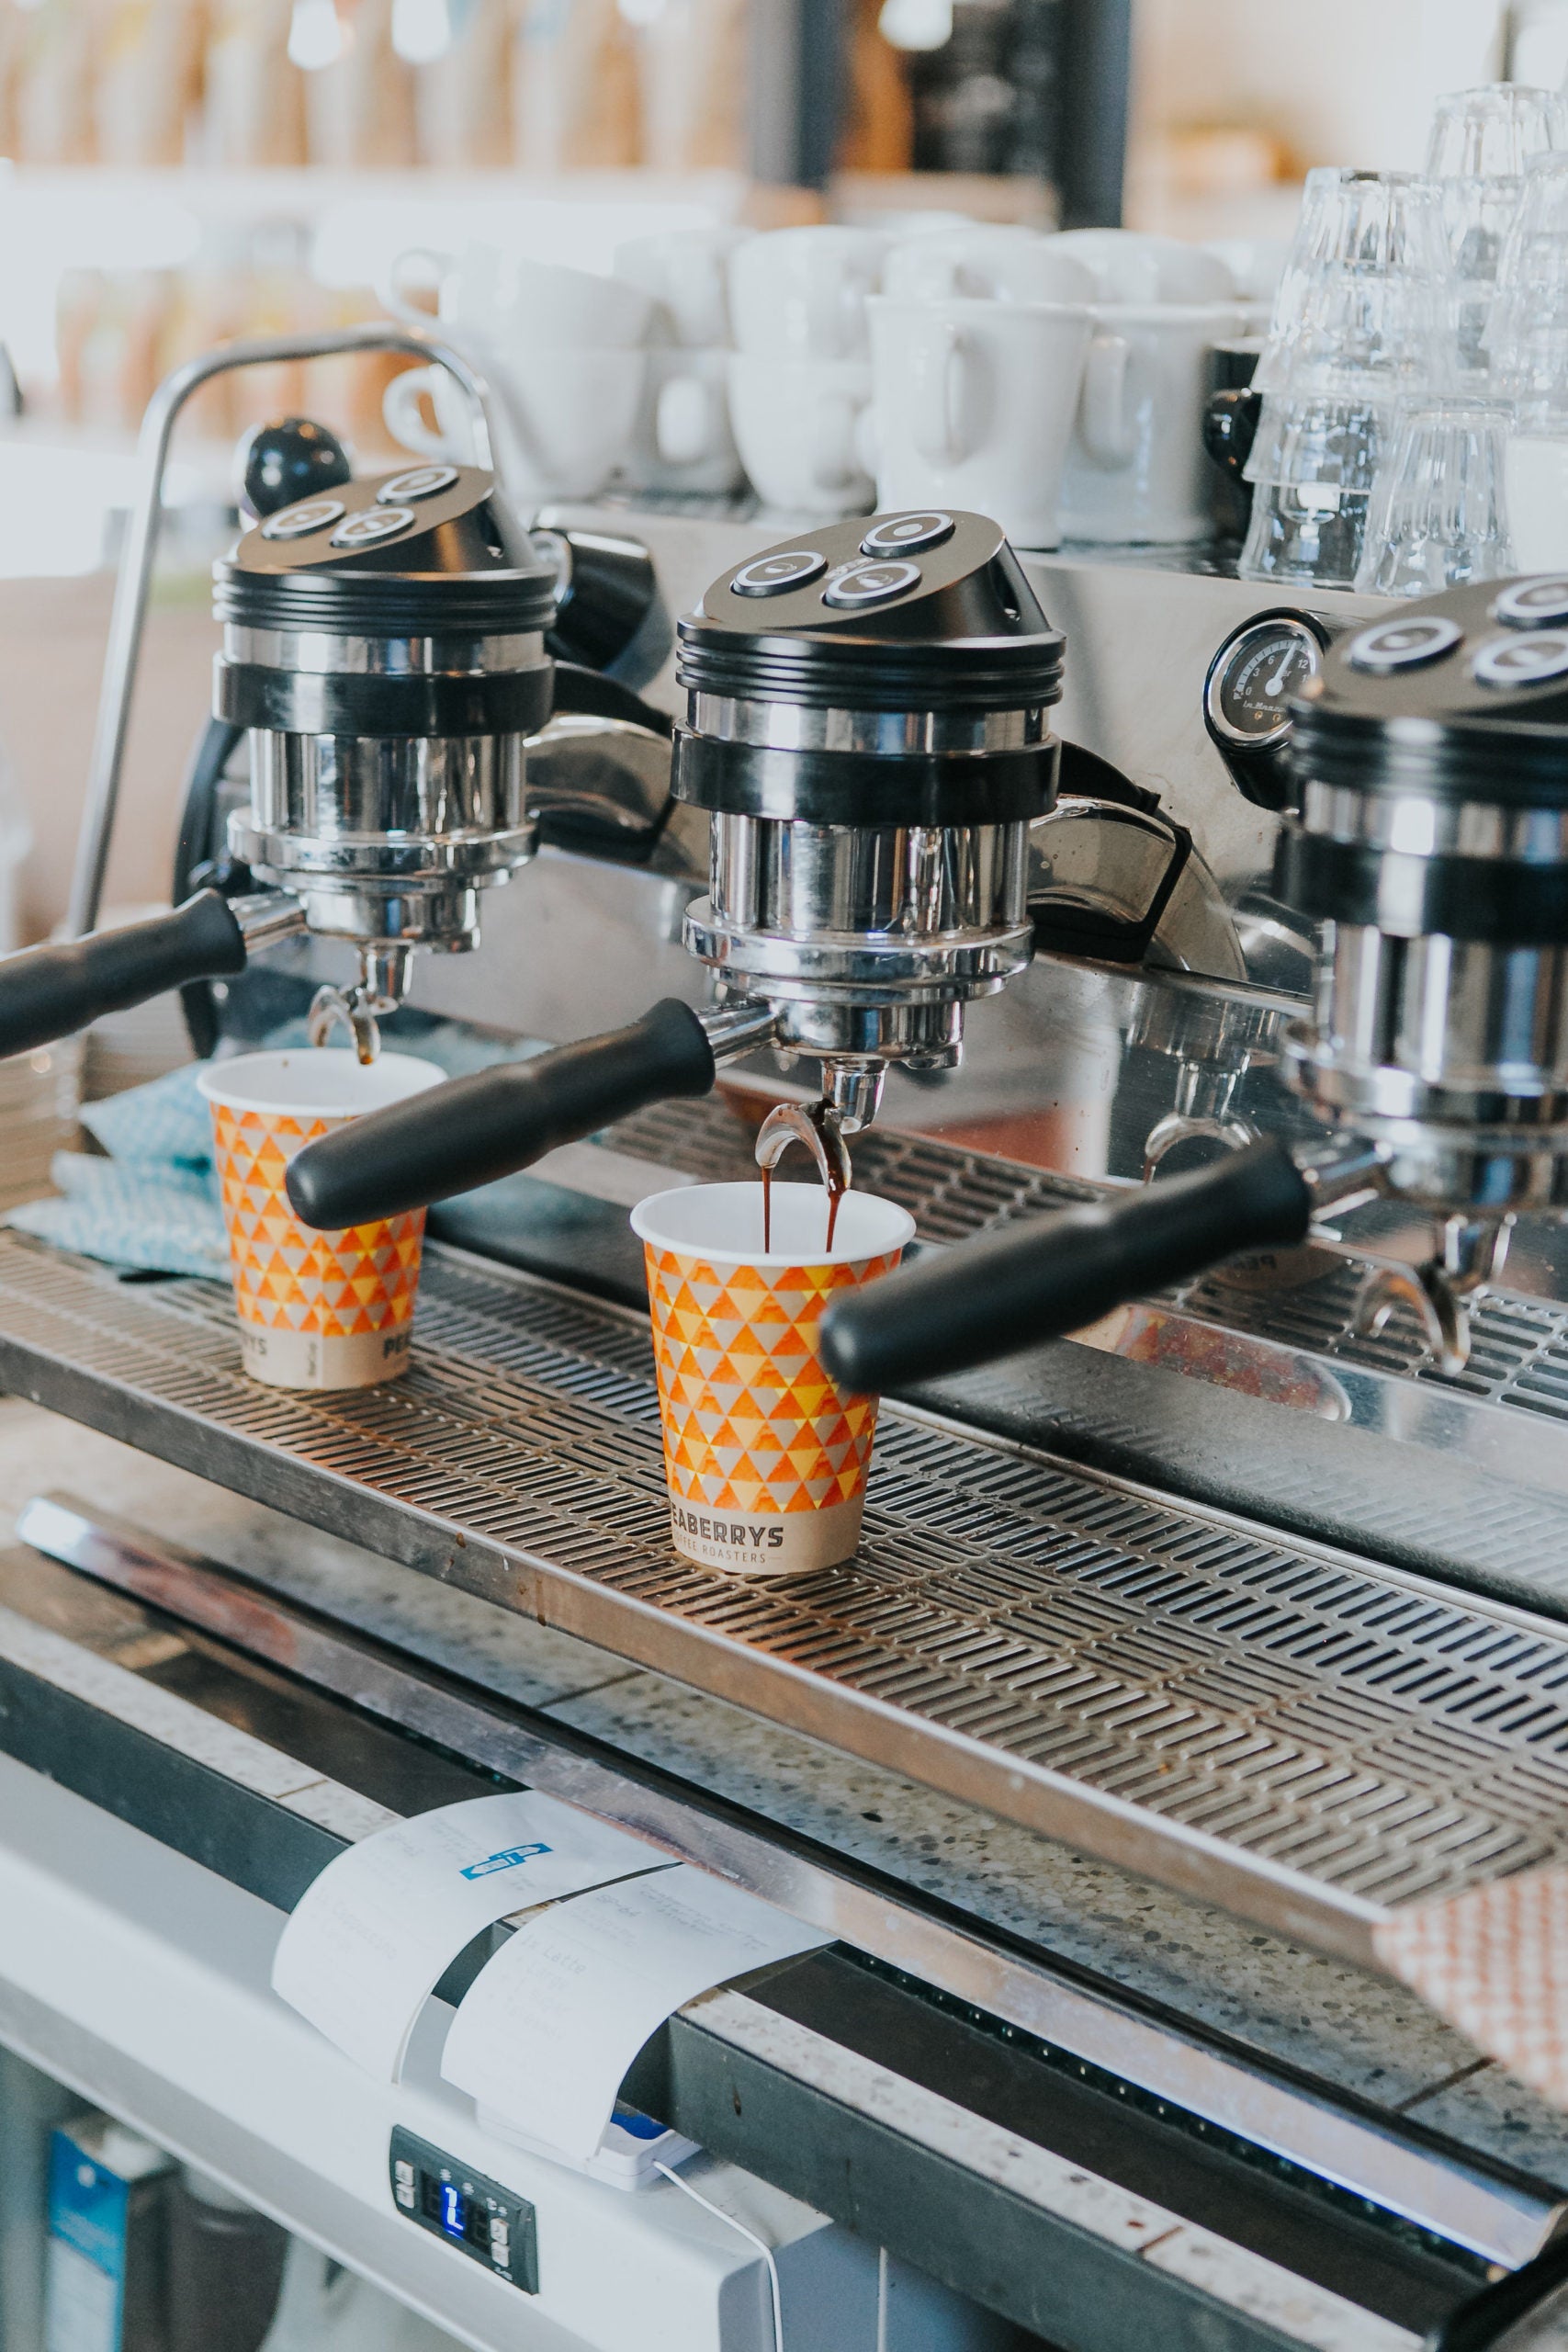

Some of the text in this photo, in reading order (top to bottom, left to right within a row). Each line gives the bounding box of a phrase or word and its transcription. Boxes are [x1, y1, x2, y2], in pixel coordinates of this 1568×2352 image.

[1268, 655, 1275, 664] 6
[1298, 660, 1309, 669] 12
[1253, 668, 1260, 677] 3
[1245, 686, 1252, 695] 0
[703, 1544, 766, 1564] ROASTERS
[542, 1945, 587, 1975] Latte
